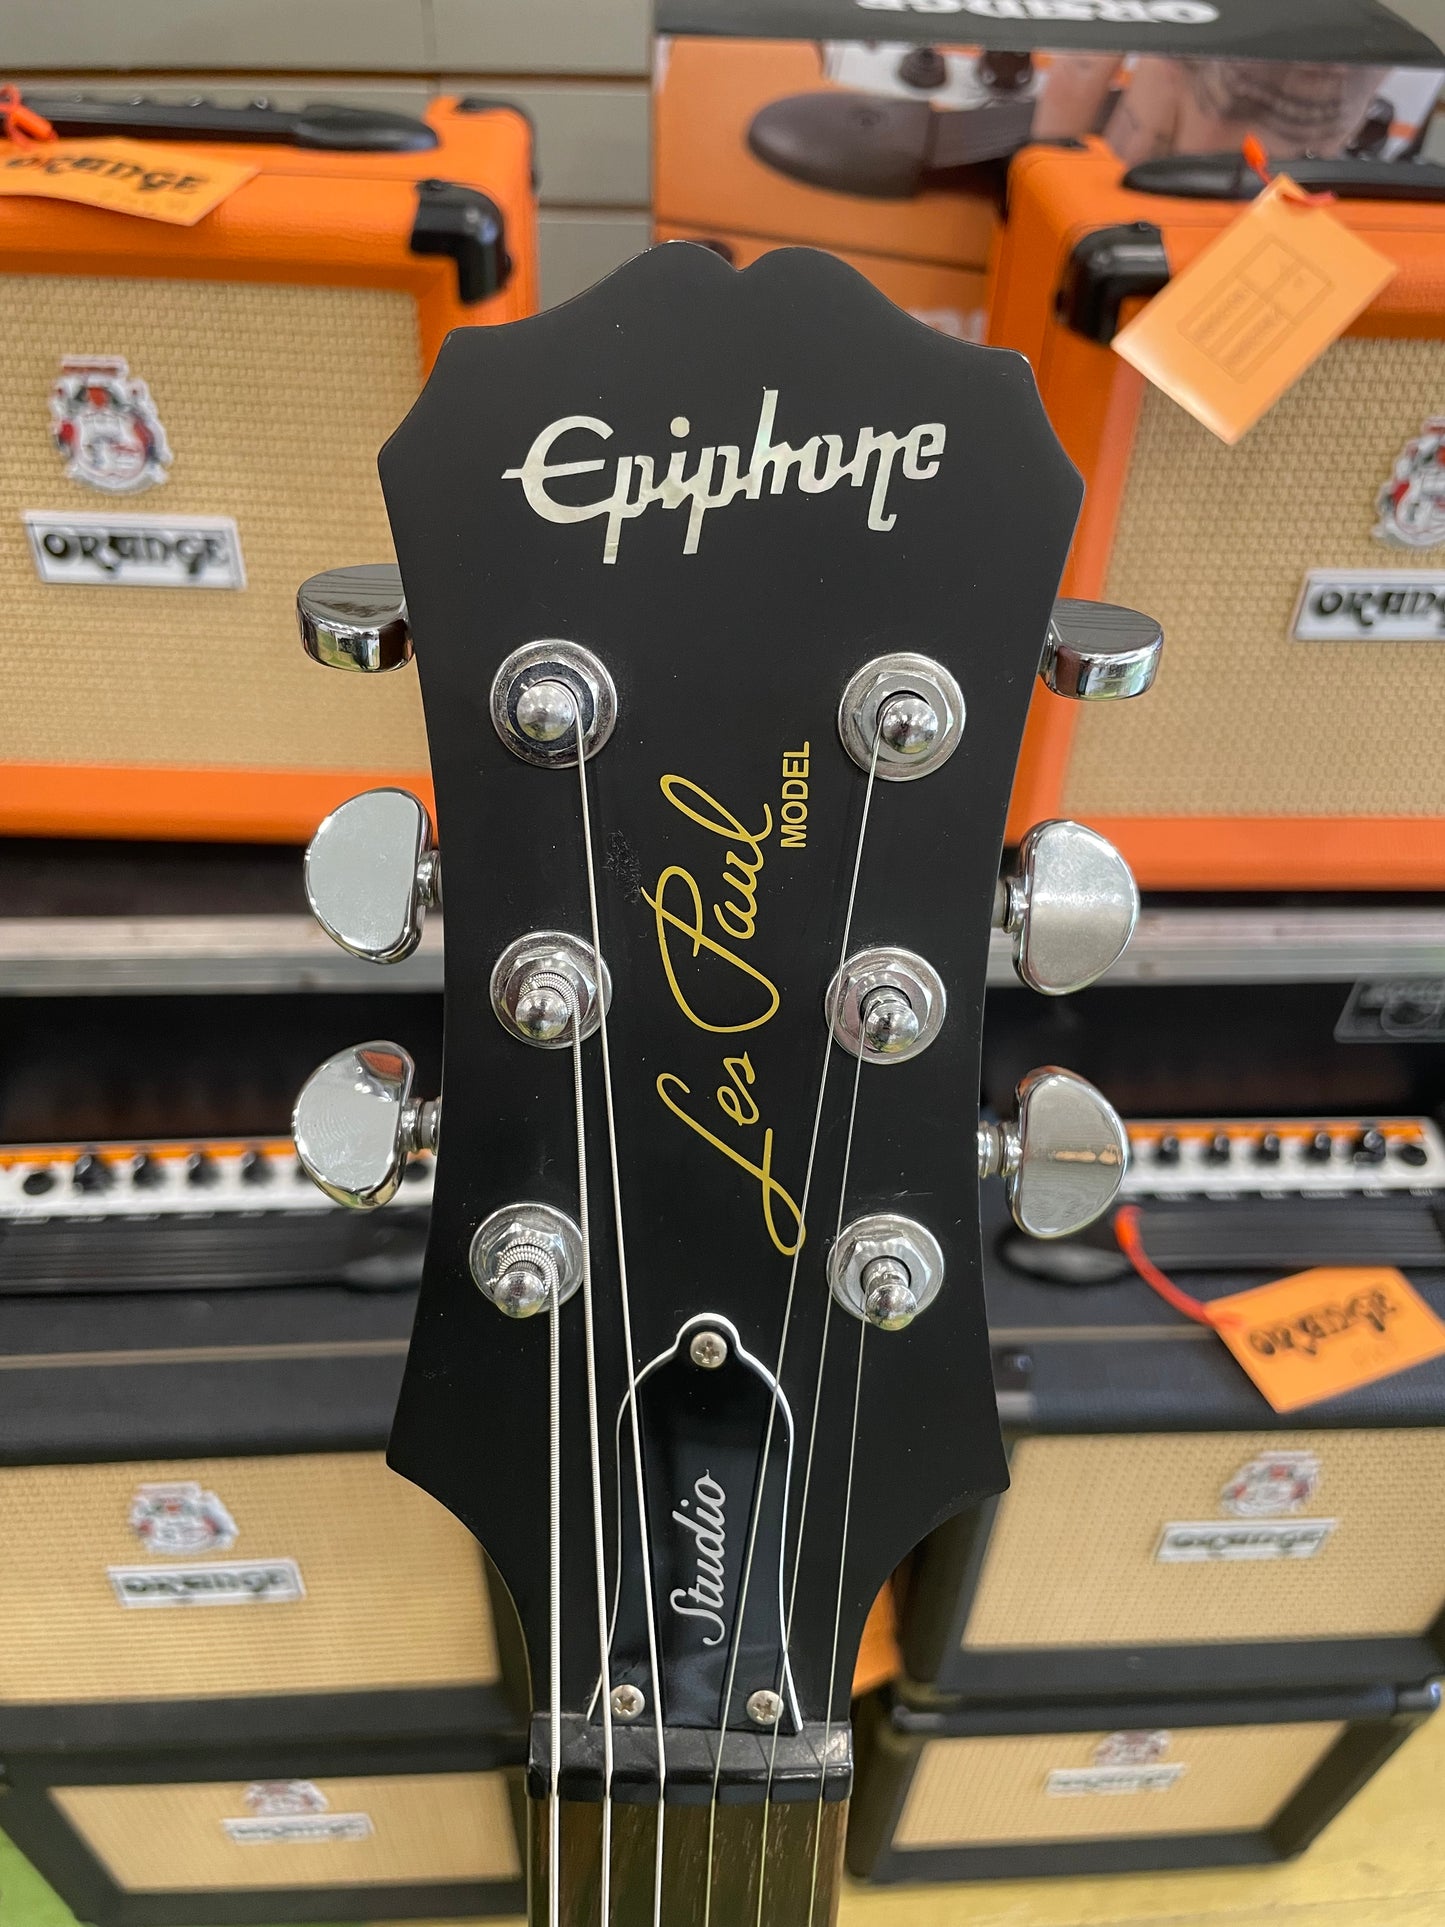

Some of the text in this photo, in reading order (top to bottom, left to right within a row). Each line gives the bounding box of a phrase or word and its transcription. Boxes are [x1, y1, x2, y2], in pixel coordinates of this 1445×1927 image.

[501, 388, 947, 565] Epiphone
[43, 533, 230, 575] ORANGE
[1314, 590, 1445, 628] ORAN
[780, 741, 811, 848] MODEL
[640, 773, 807, 1257] Les Paul
[669, 1468, 727, 1646] Studio
